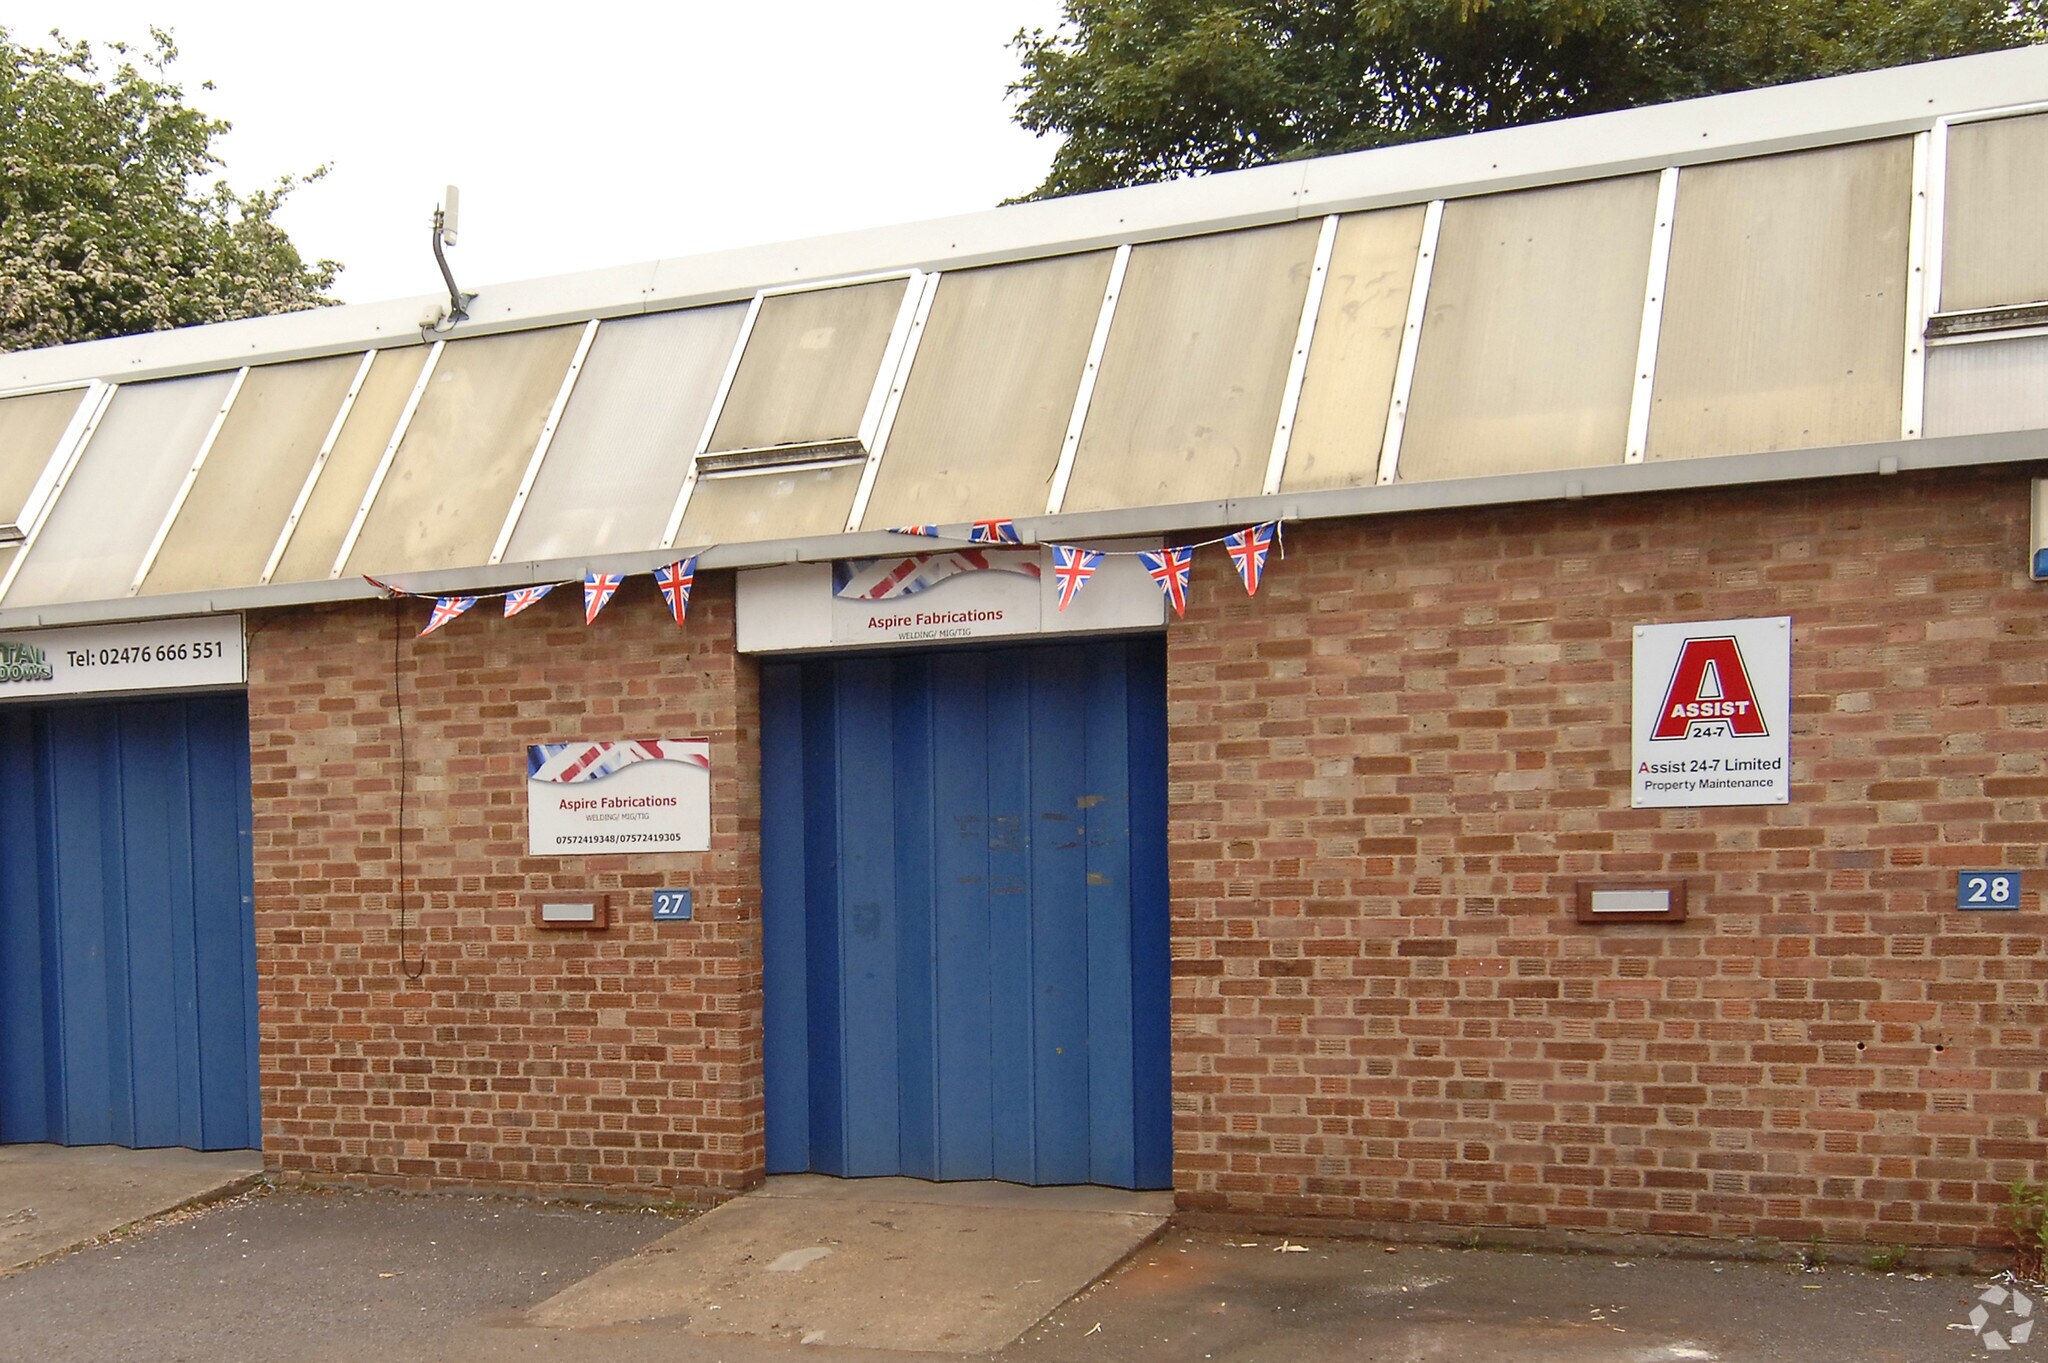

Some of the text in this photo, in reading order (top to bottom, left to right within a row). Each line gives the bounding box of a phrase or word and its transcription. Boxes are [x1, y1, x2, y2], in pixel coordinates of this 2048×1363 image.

[868, 609, 1003, 630] Aspire Fabrications
[939, 628, 971, 637] MIG/TIG
[67, 641, 222, 667] Tel: 02476 666 551
[1671, 701, 1750, 718] ASSIST
[1693, 727, 1725, 738] 24-7
[1638, 757, 1781, 774] Assist 24-7 Limited
[1644, 778, 1774, 791] Property Maintenance
[559, 795, 677, 811] Aspire Fabrications
[621, 812, 649, 820] MIG/TIG
[1968, 877, 2010, 902] 28
[657, 894, 684, 914] 27
